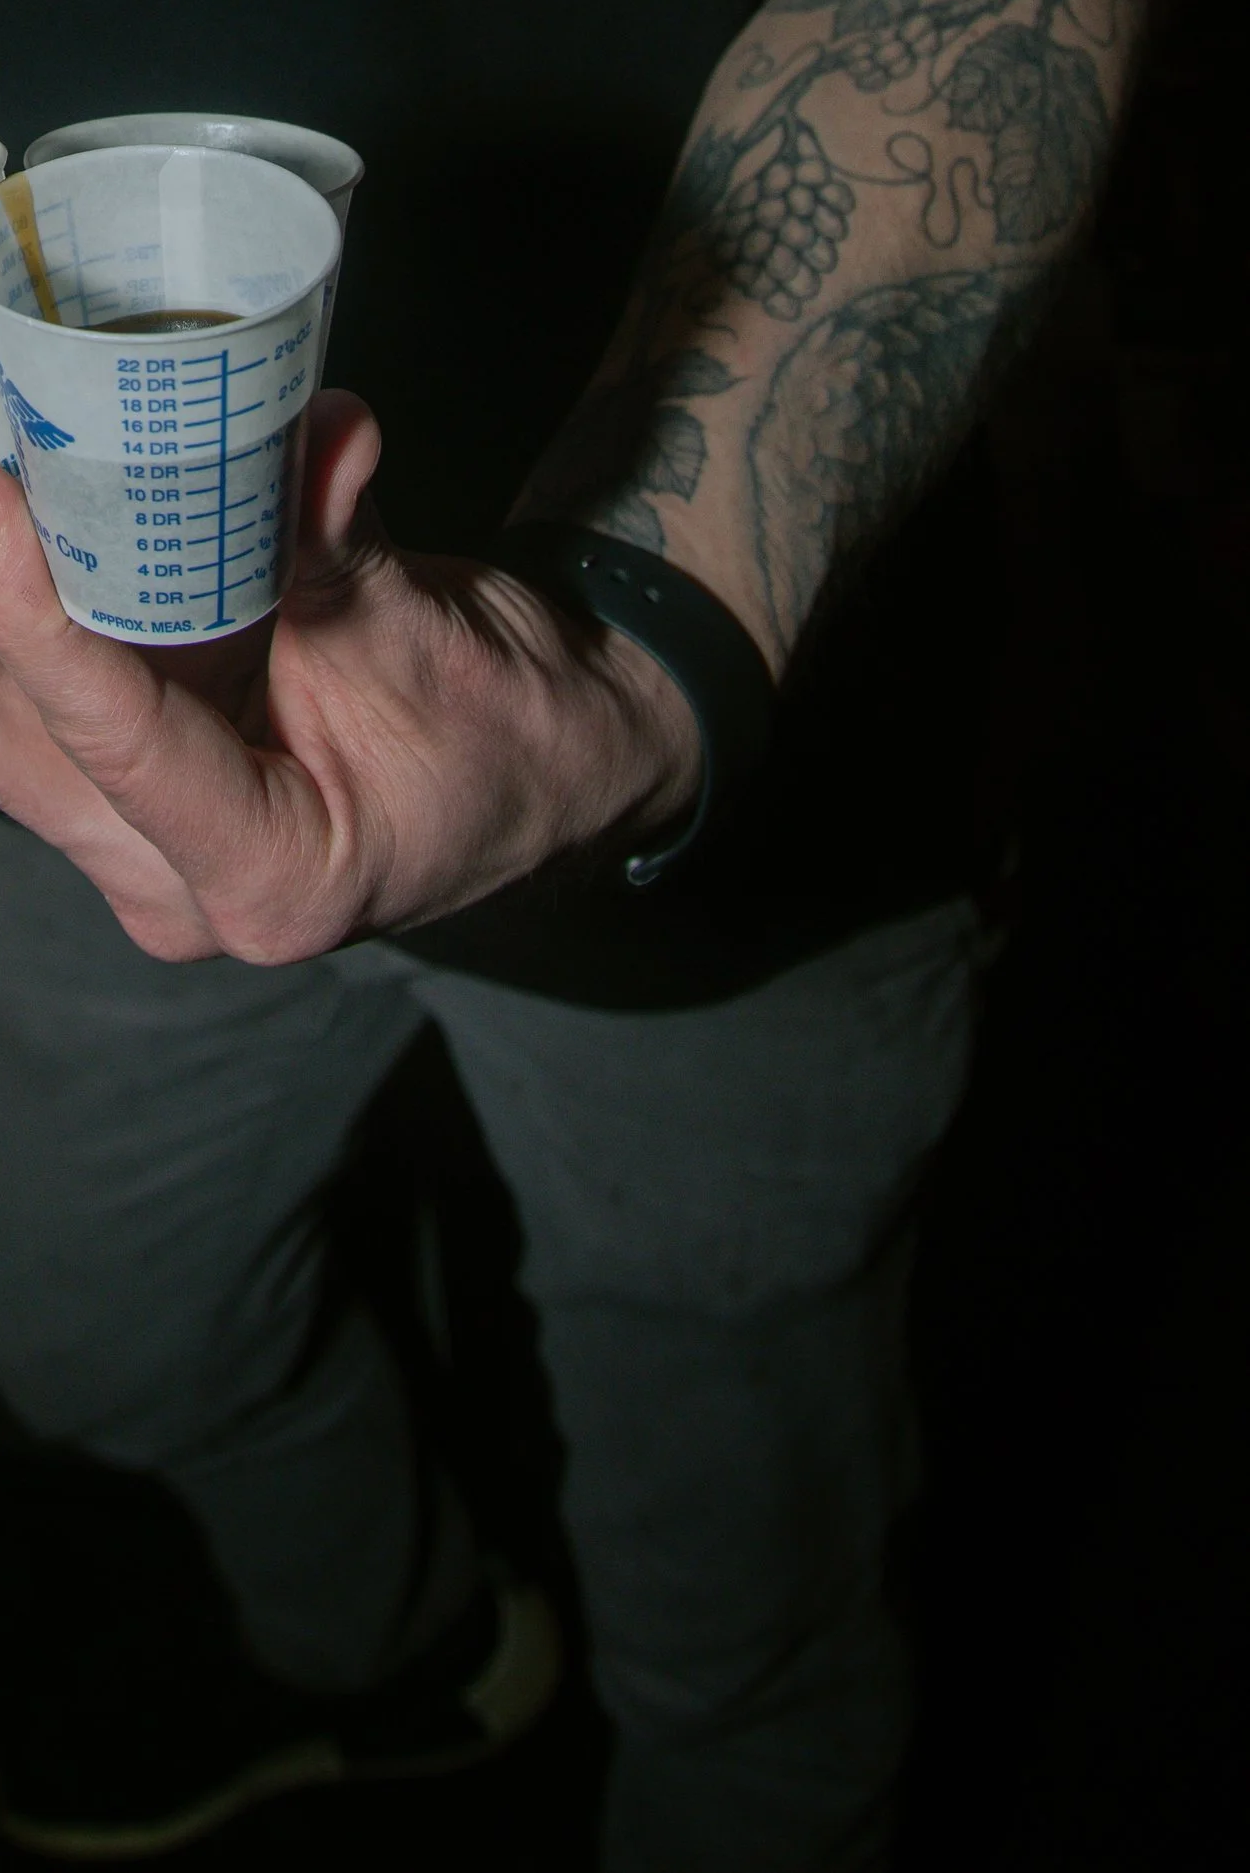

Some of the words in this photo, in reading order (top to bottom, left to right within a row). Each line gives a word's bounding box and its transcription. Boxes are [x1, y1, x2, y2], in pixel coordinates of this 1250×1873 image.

[118, 359, 140, 373] 22
[146, 359, 175, 373] DR
[119, 378, 141, 392] 20
[147, 378, 176, 392] DR
[121, 399, 142, 413] 18
[148, 399, 177, 413] DR
[122, 419, 143, 433] 16
[149, 419, 178, 433] DR
[123, 441, 144, 455] 14
[150, 441, 178, 455] DR
[124, 465, 145, 479] 12
[151, 465, 179, 479] DR
[125, 488, 146, 502] 10
[152, 489, 180, 502] DR
[135, 512, 147, 525] 8
[153, 513, 181, 526] DR
[137, 538, 148, 551] 6
[154, 539, 182, 552] DR
[56, 534, 97, 573] Cup
[137, 564, 150, 576] 4
[154, 564, 183, 577] DR
[139, 591, 150, 603] 2
[156, 592, 184, 604] DR
[92, 609, 148, 632] APPROX.
[151, 619, 196, 633] MEAS.
